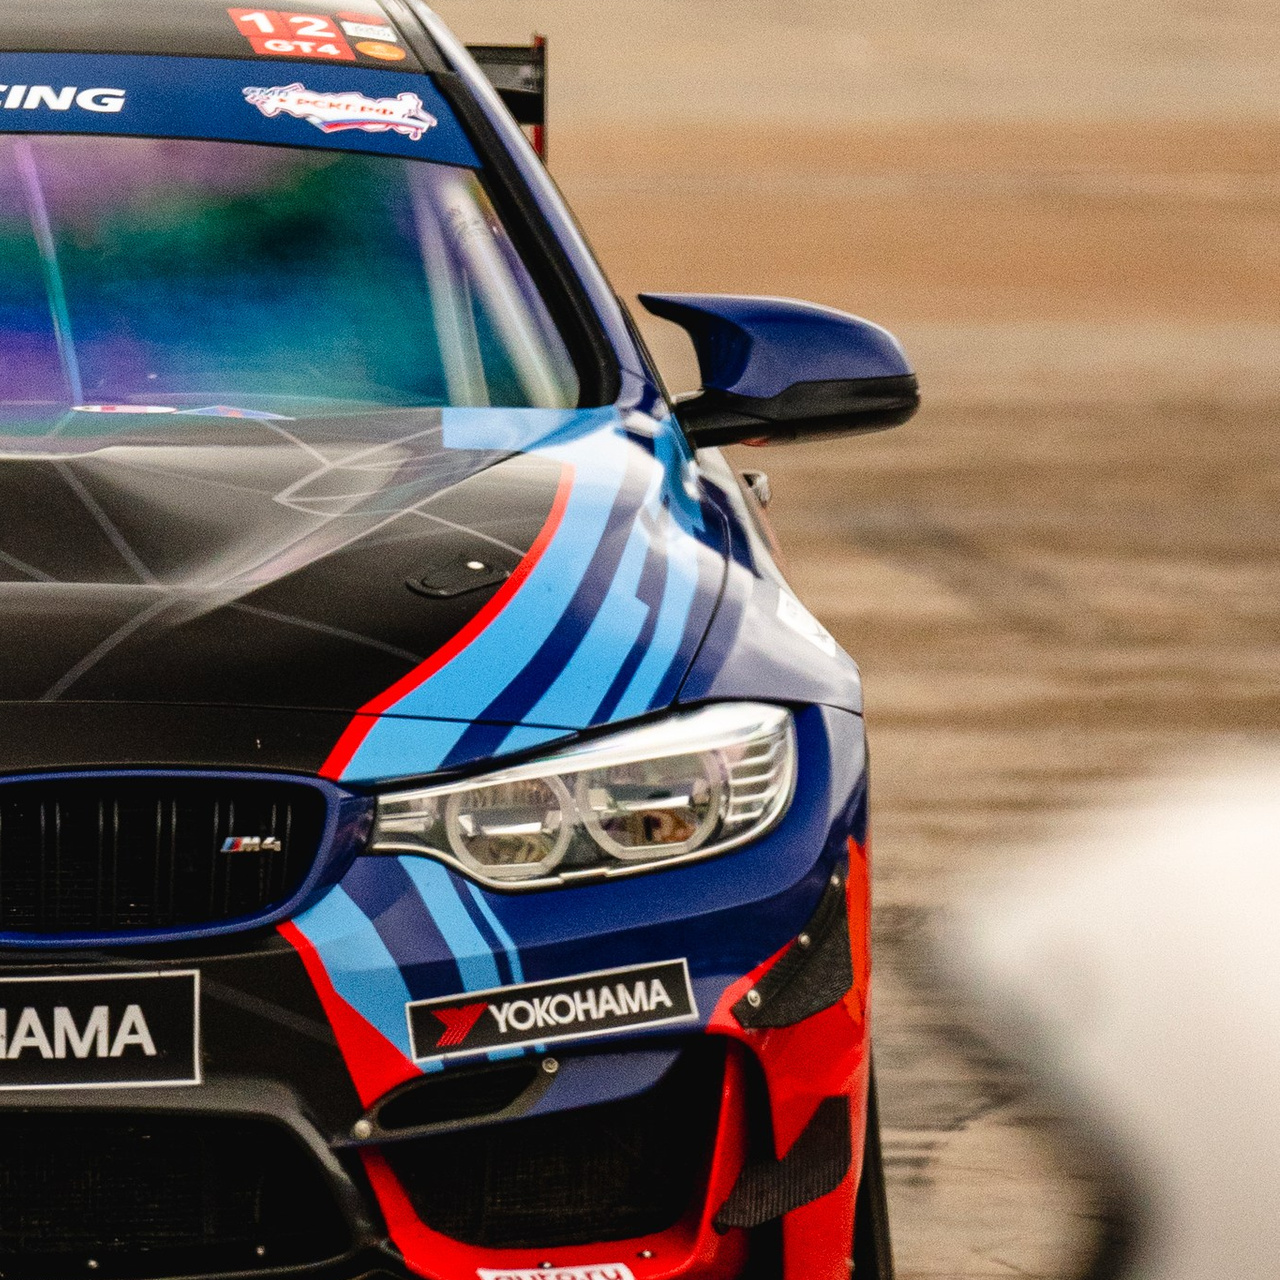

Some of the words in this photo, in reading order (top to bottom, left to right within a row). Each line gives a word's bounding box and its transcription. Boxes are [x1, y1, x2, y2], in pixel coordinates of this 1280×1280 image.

[264, 40, 341, 57] GT4
[239, 836, 281, 852] M4
[488, 978, 672, 1033] YOKOHAMA
